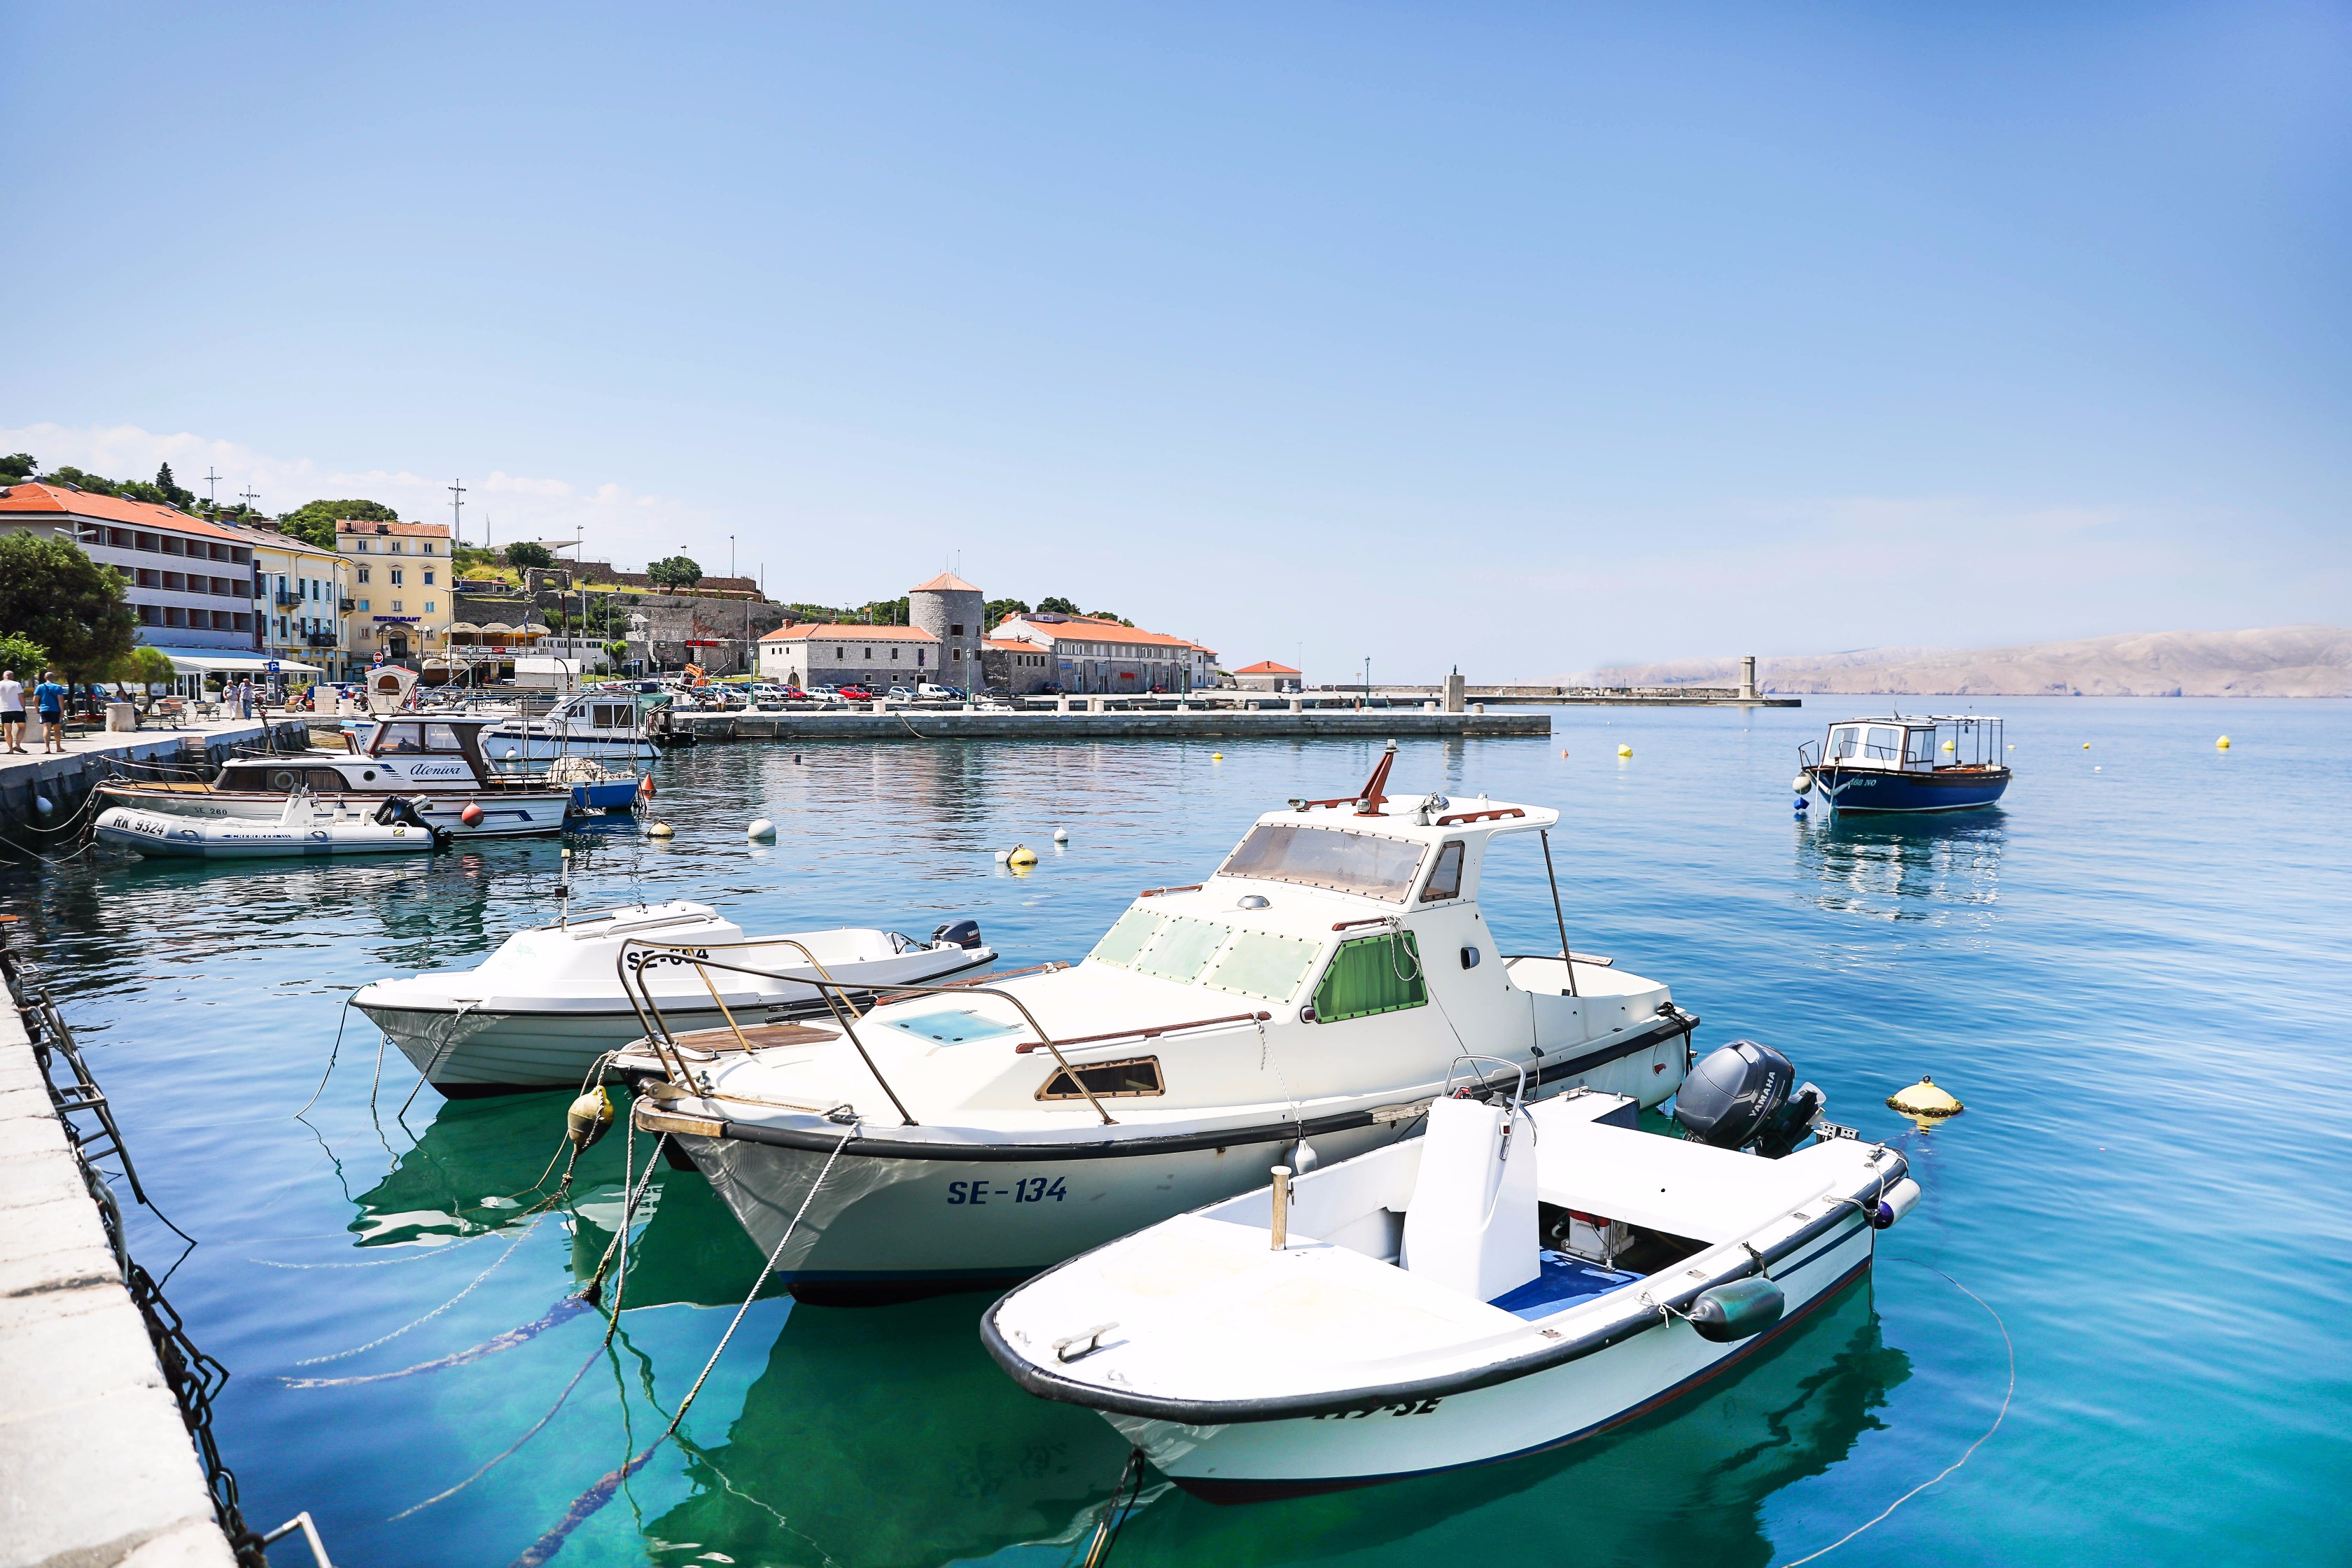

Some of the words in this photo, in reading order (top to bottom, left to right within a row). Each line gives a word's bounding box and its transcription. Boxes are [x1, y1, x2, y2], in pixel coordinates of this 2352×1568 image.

[113, 815, 130, 829] RK
[135, 819, 166, 836] 9324
[378, 807, 392, 824] TOHATSU
[1748, 1071, 1776, 1117] YAMAHA
